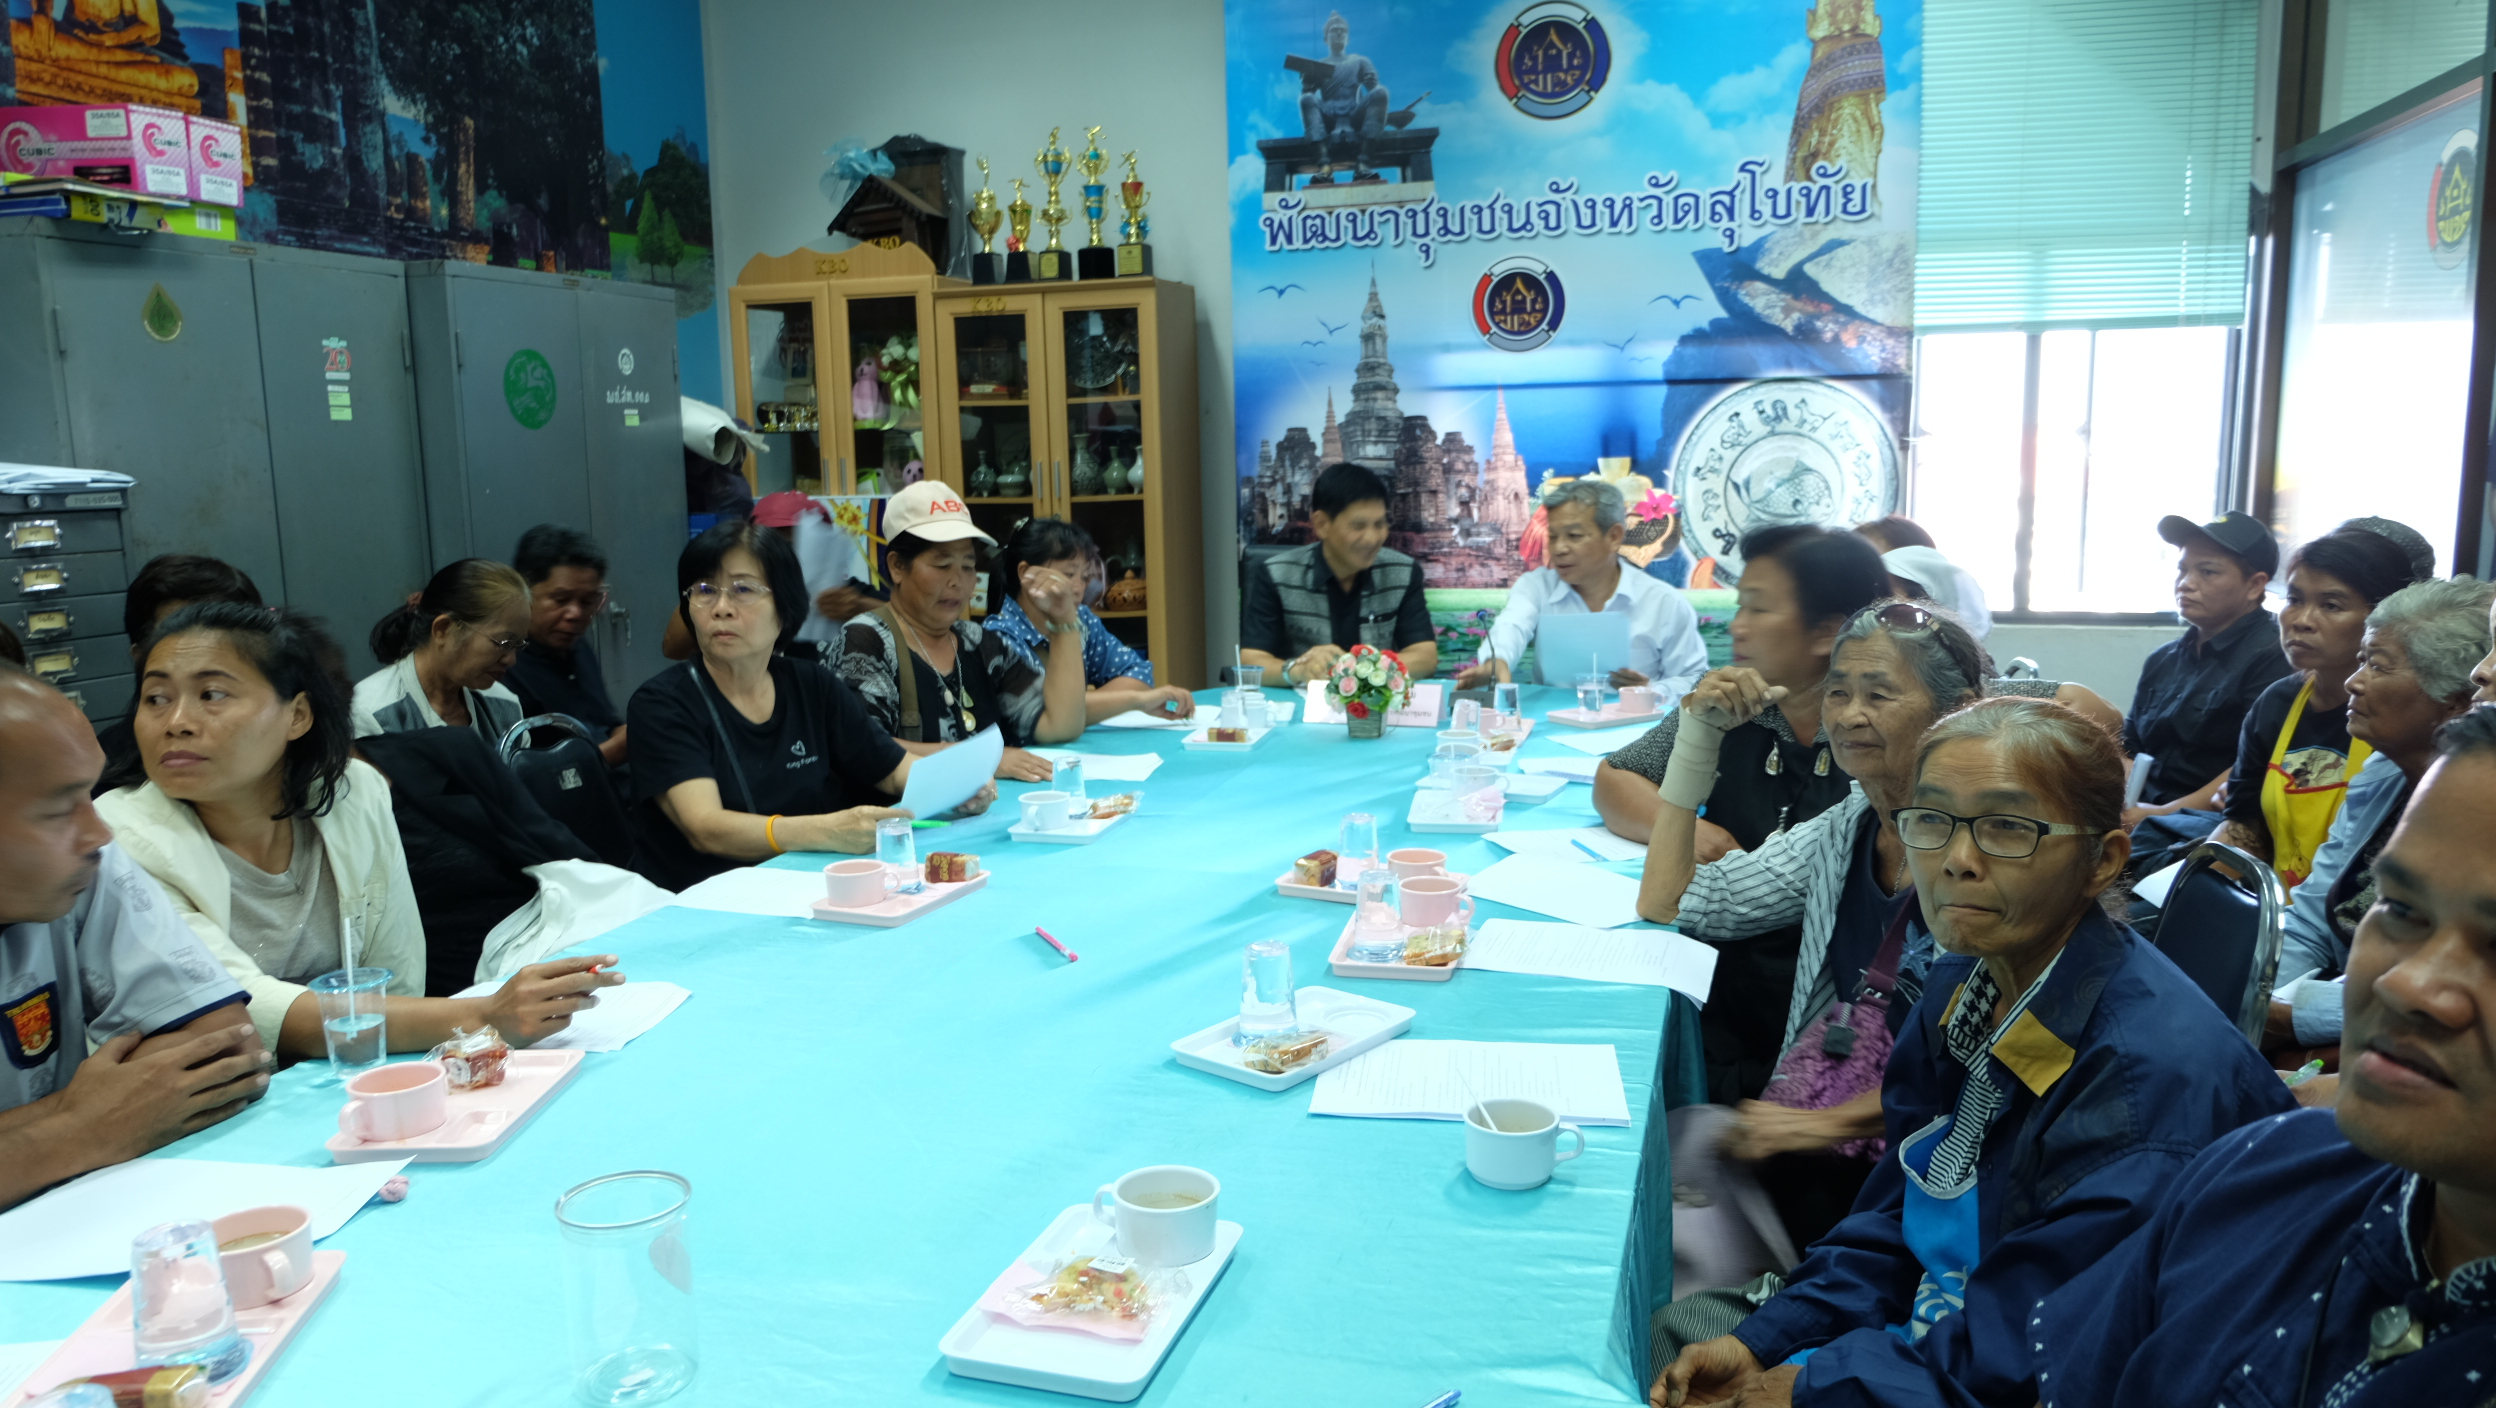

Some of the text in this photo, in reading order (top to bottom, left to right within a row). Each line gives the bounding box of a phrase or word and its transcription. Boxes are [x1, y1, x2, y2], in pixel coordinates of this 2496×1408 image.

[153, 137, 182, 149] CUBIC
[18, 147, 55, 157] CUBIC
[210, 149, 237, 162] CUBIC
[1262, 160, 1874, 263] พัฒนาชุมชนจังหวัดสุโขทัย
[815, 258, 849, 275] KBO
[971, 296, 1007, 312] KBO
